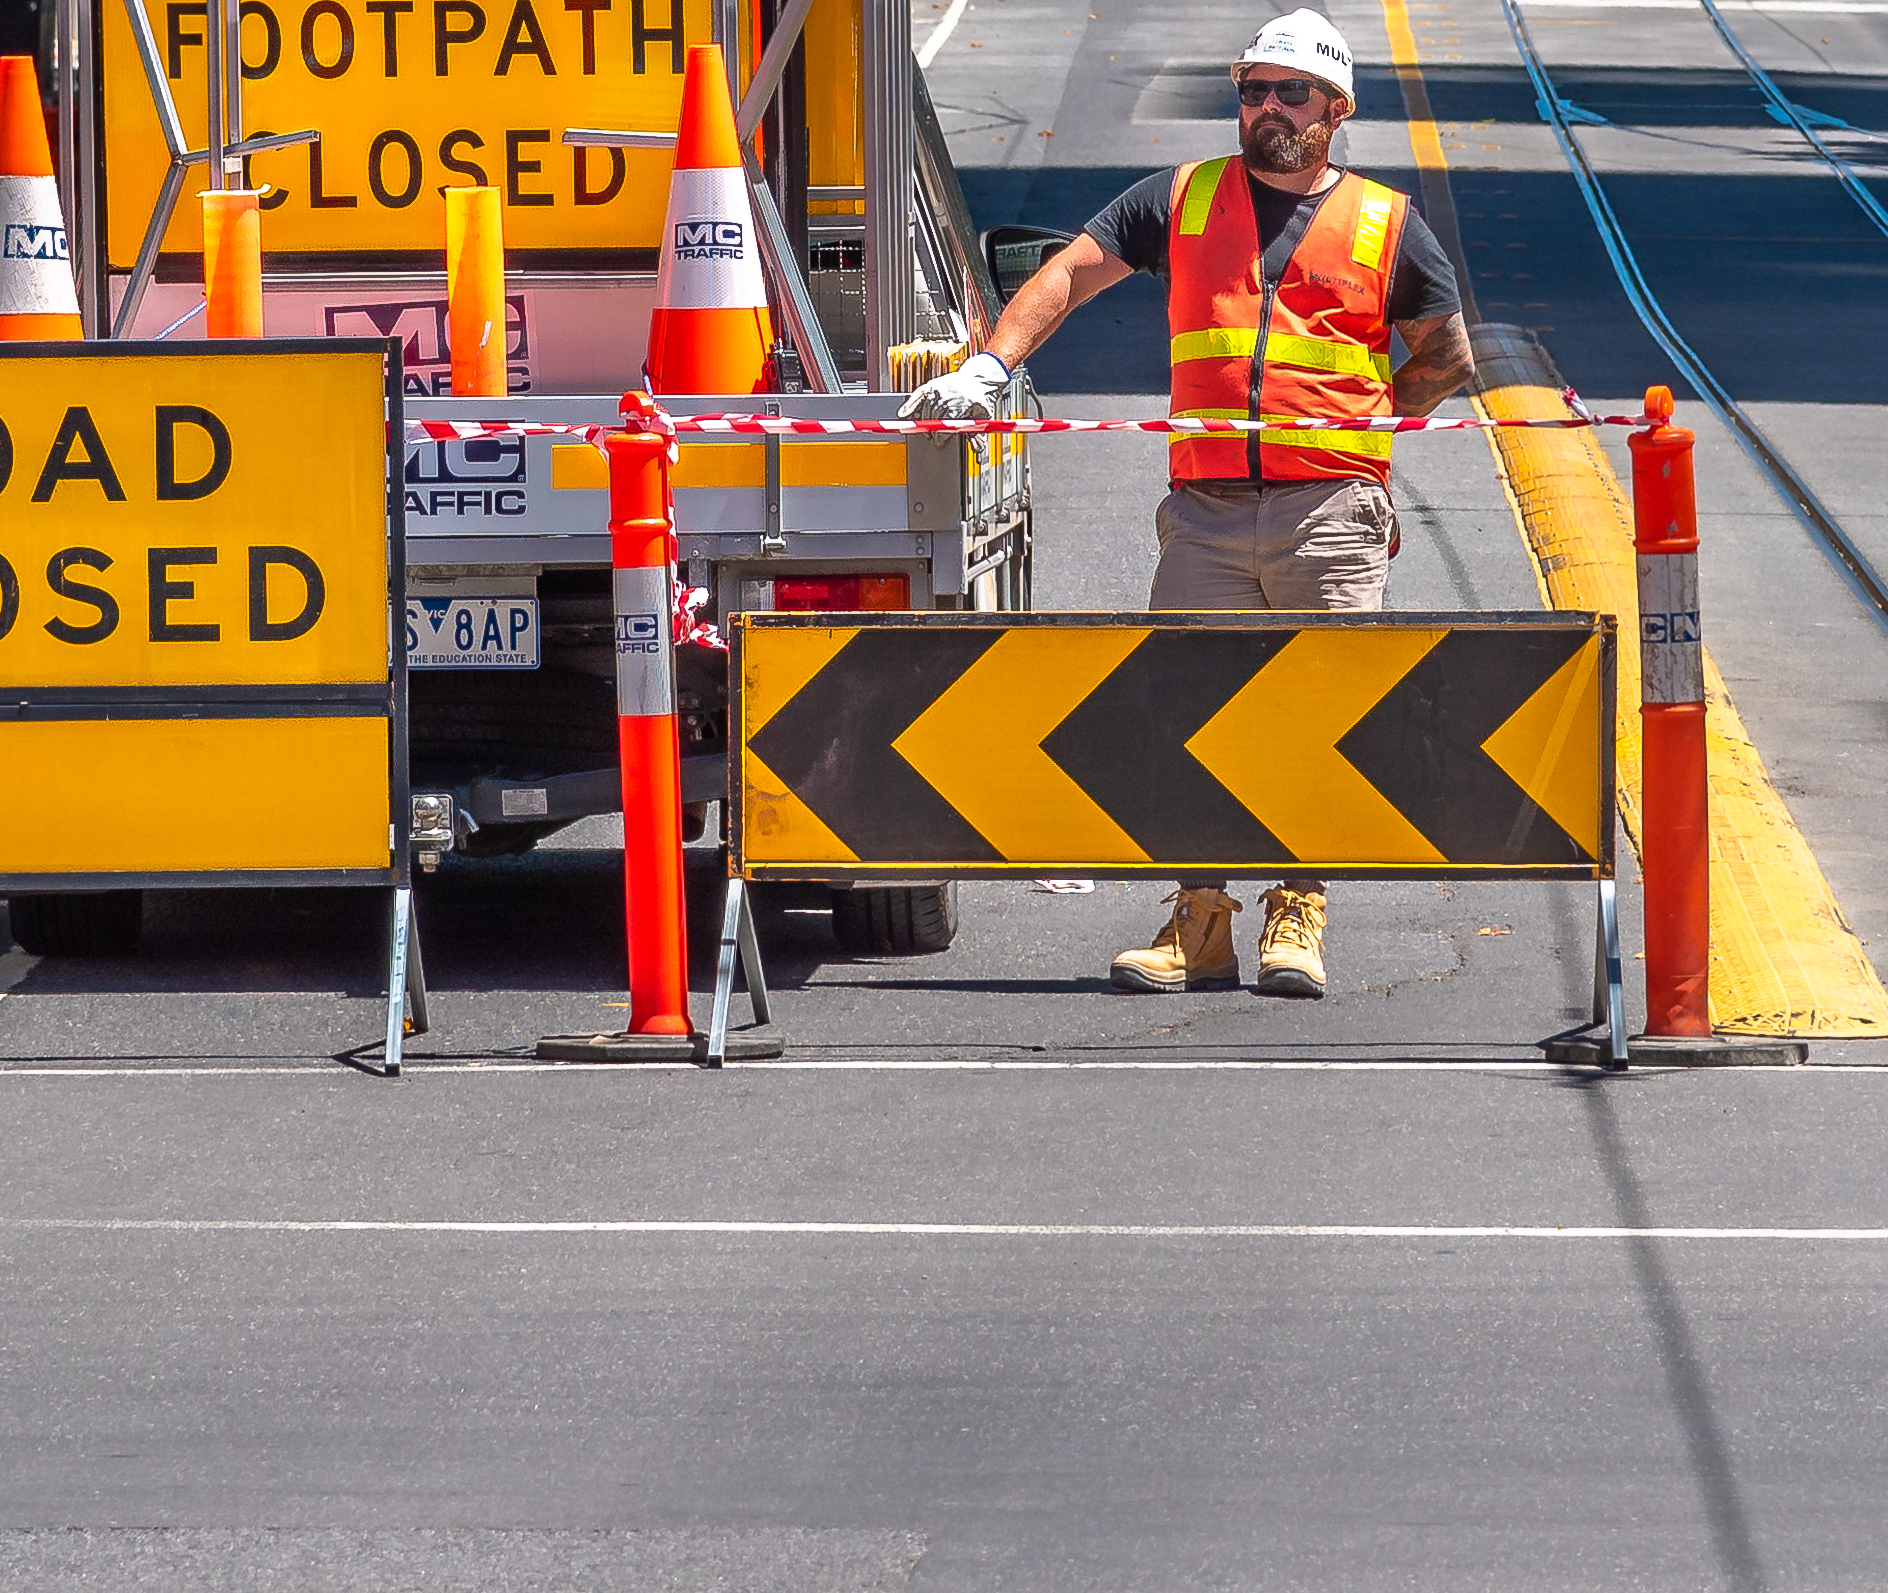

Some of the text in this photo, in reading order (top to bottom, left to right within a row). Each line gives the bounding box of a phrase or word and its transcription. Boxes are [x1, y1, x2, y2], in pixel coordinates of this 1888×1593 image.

[676, 222, 742, 246] MC
[675, 248, 743, 261] TRAFFIC
[1310, 271, 1365, 295] MULTIPLEX
[405, 489, 527, 517] AFFIC
[428, 609, 446, 619] VIC
[455, 607, 530, 652] 8AP
[616, 641, 660, 654] AFFIC
[408, 654, 527, 664] THE EDUCATION STATE
